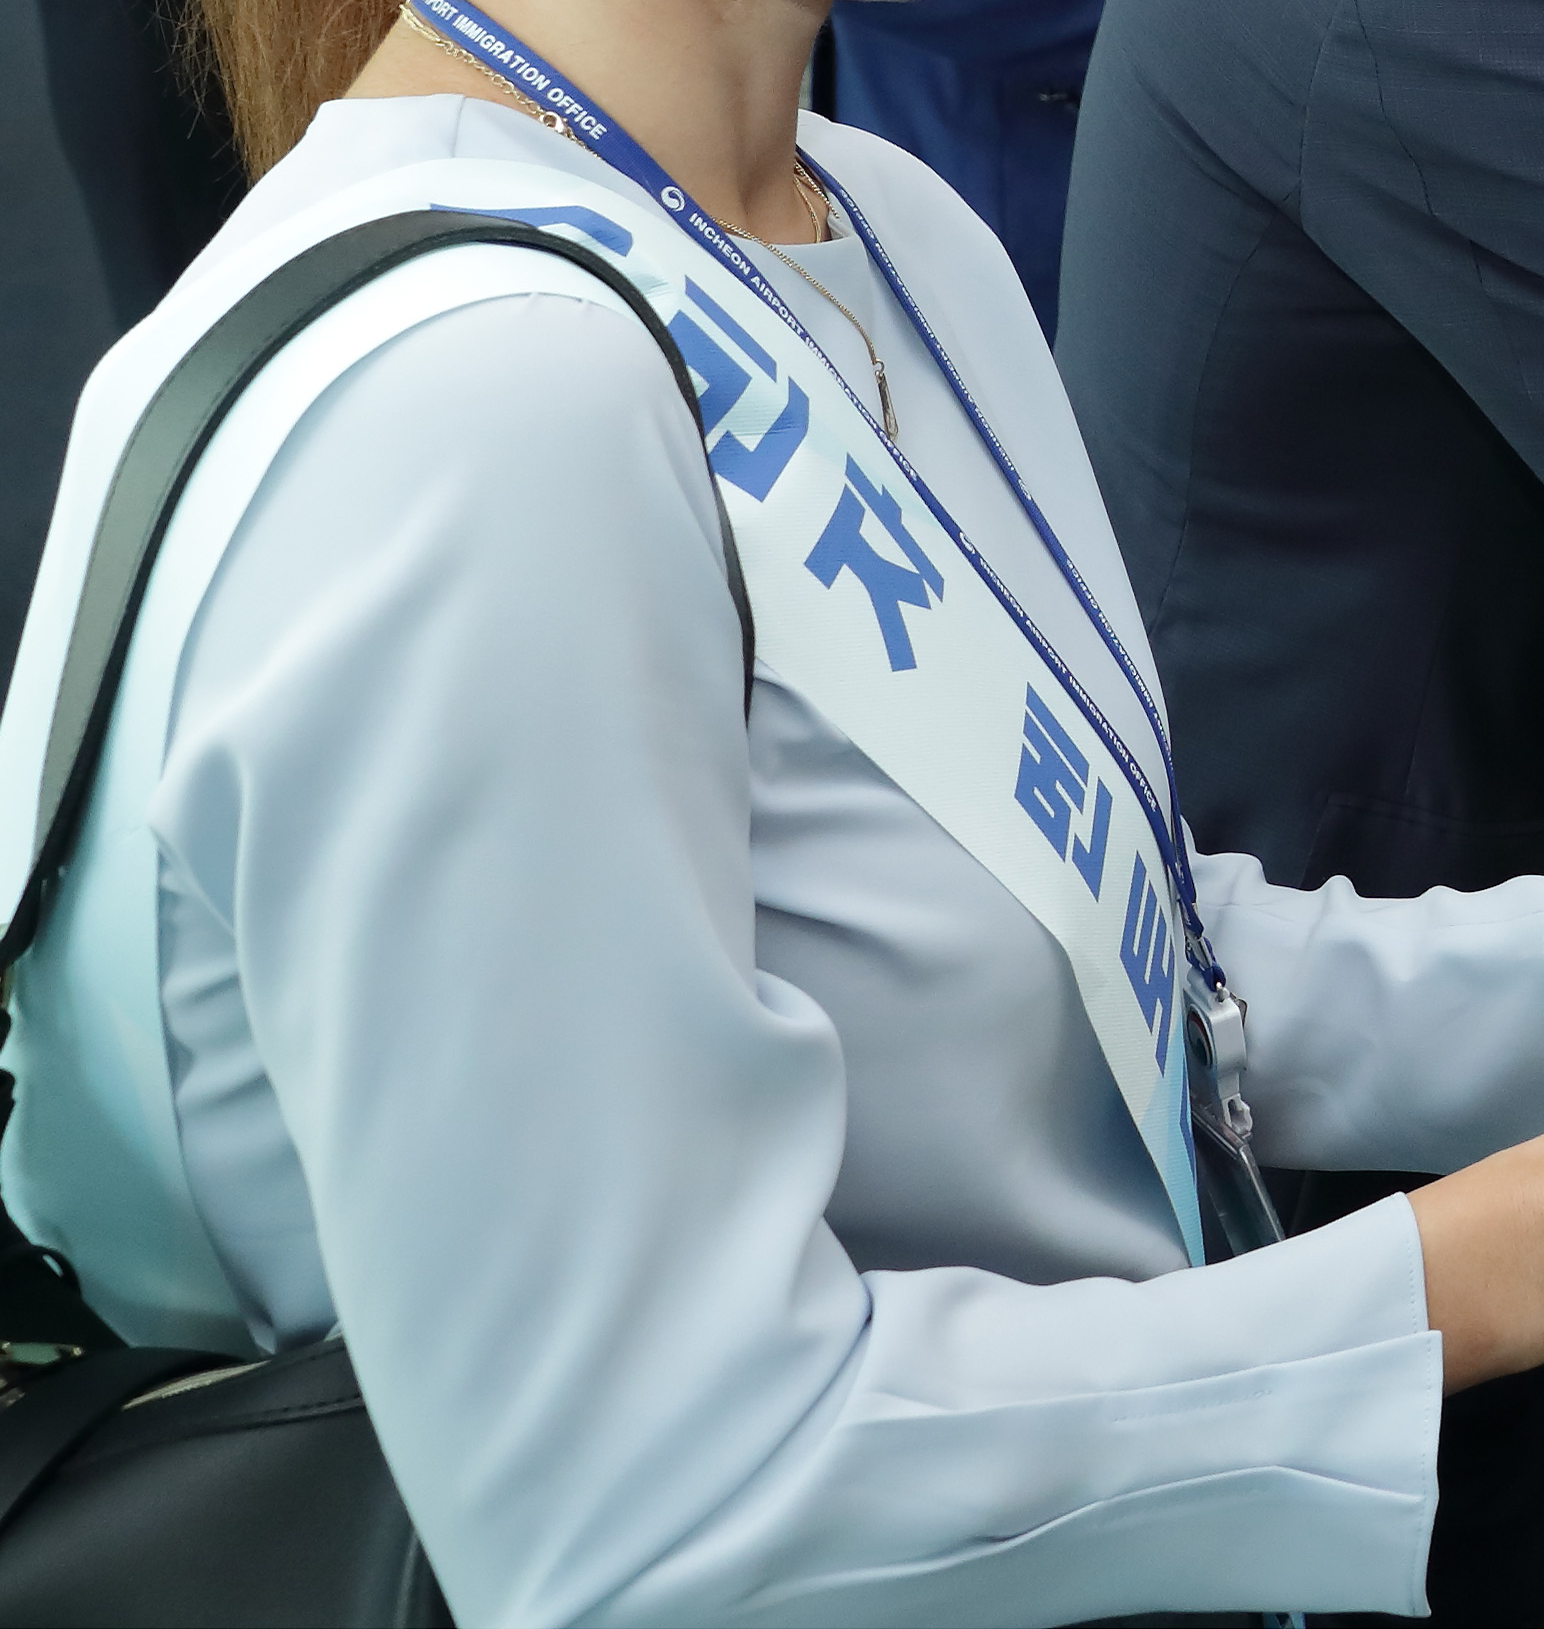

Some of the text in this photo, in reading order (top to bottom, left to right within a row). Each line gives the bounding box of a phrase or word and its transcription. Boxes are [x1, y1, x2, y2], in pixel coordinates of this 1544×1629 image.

[451, 14, 550, 91] IMMIGRATION
[544, 85, 608, 141] OFFICE
[687, 211, 752, 276] INCHEON
[749, 274, 803, 335] AIRPORT
[1067, 676, 1131, 762] IMMIGRATION
[1124, 759, 1162, 814] OFFICE
[1014, 682, 1195, 1186] 멘토
